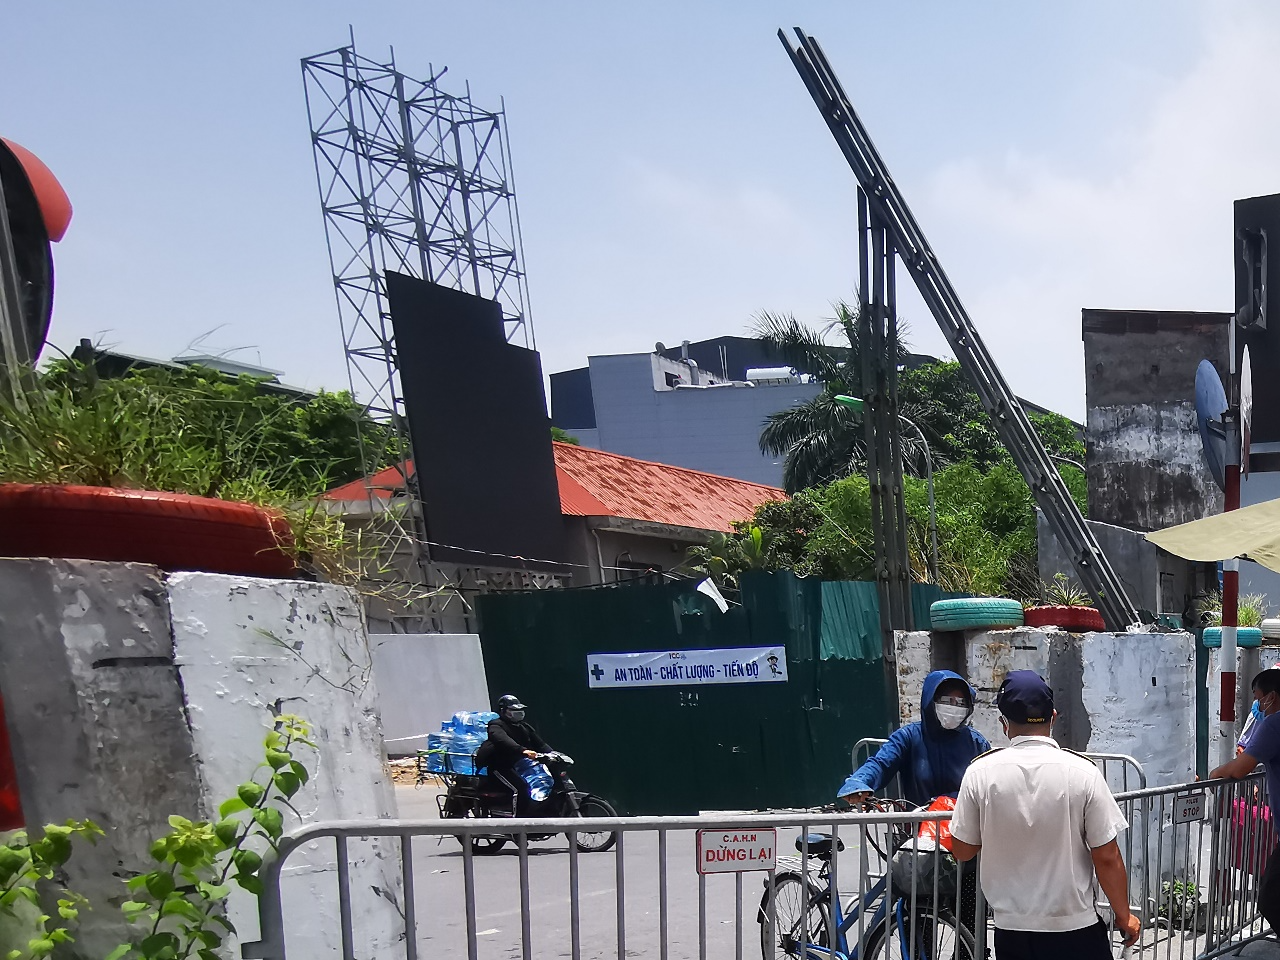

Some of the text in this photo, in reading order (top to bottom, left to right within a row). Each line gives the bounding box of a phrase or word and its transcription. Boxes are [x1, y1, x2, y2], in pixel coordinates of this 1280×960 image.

[614, 668, 627, 682] AN
[629, 665, 651, 681] TOÀN
[660, 661, 683, 680] CHẤT
[685, 665, 715, 682] LƯỢNG
[723, 660, 744, 678] TIẾN
[746, 660, 759, 679] ĐỘ
[1182, 806, 1200, 818] STOP
[723, 834, 757, 842] C.A.H.N
[705, 844, 772, 863] DỪNG LẠI
